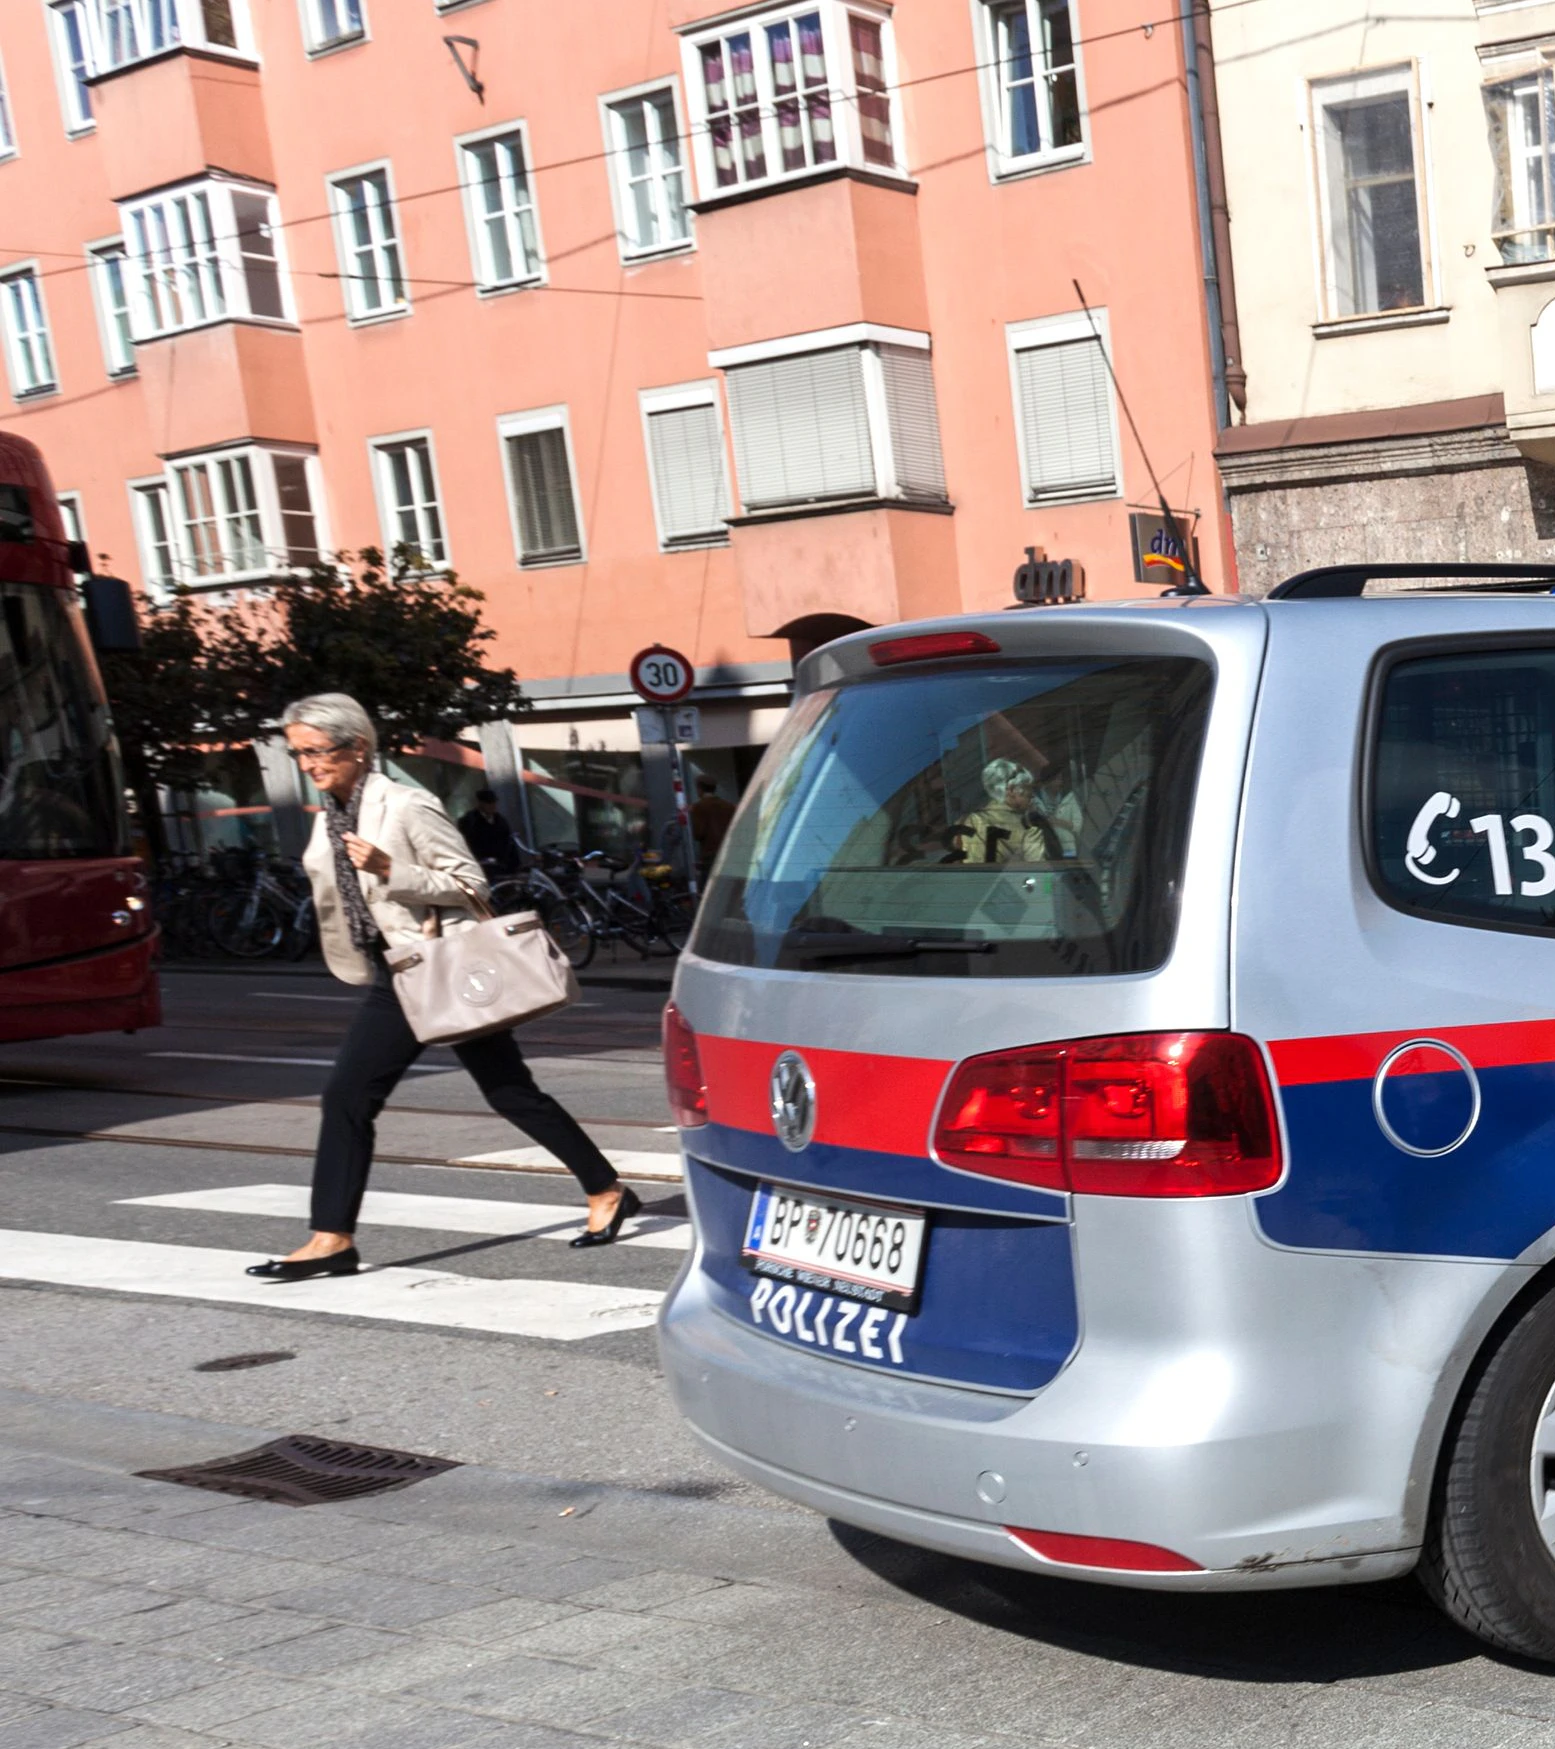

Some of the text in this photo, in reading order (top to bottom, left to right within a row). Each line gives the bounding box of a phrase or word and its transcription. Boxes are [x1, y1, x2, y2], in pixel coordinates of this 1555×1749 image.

[1014, 546, 1085, 604] dm
[646, 662, 678, 688] 30
[770, 1195, 804, 1249] BP
[817, 1205, 905, 1275] 70668
[750, 1276, 909, 1364] POLIZEI
